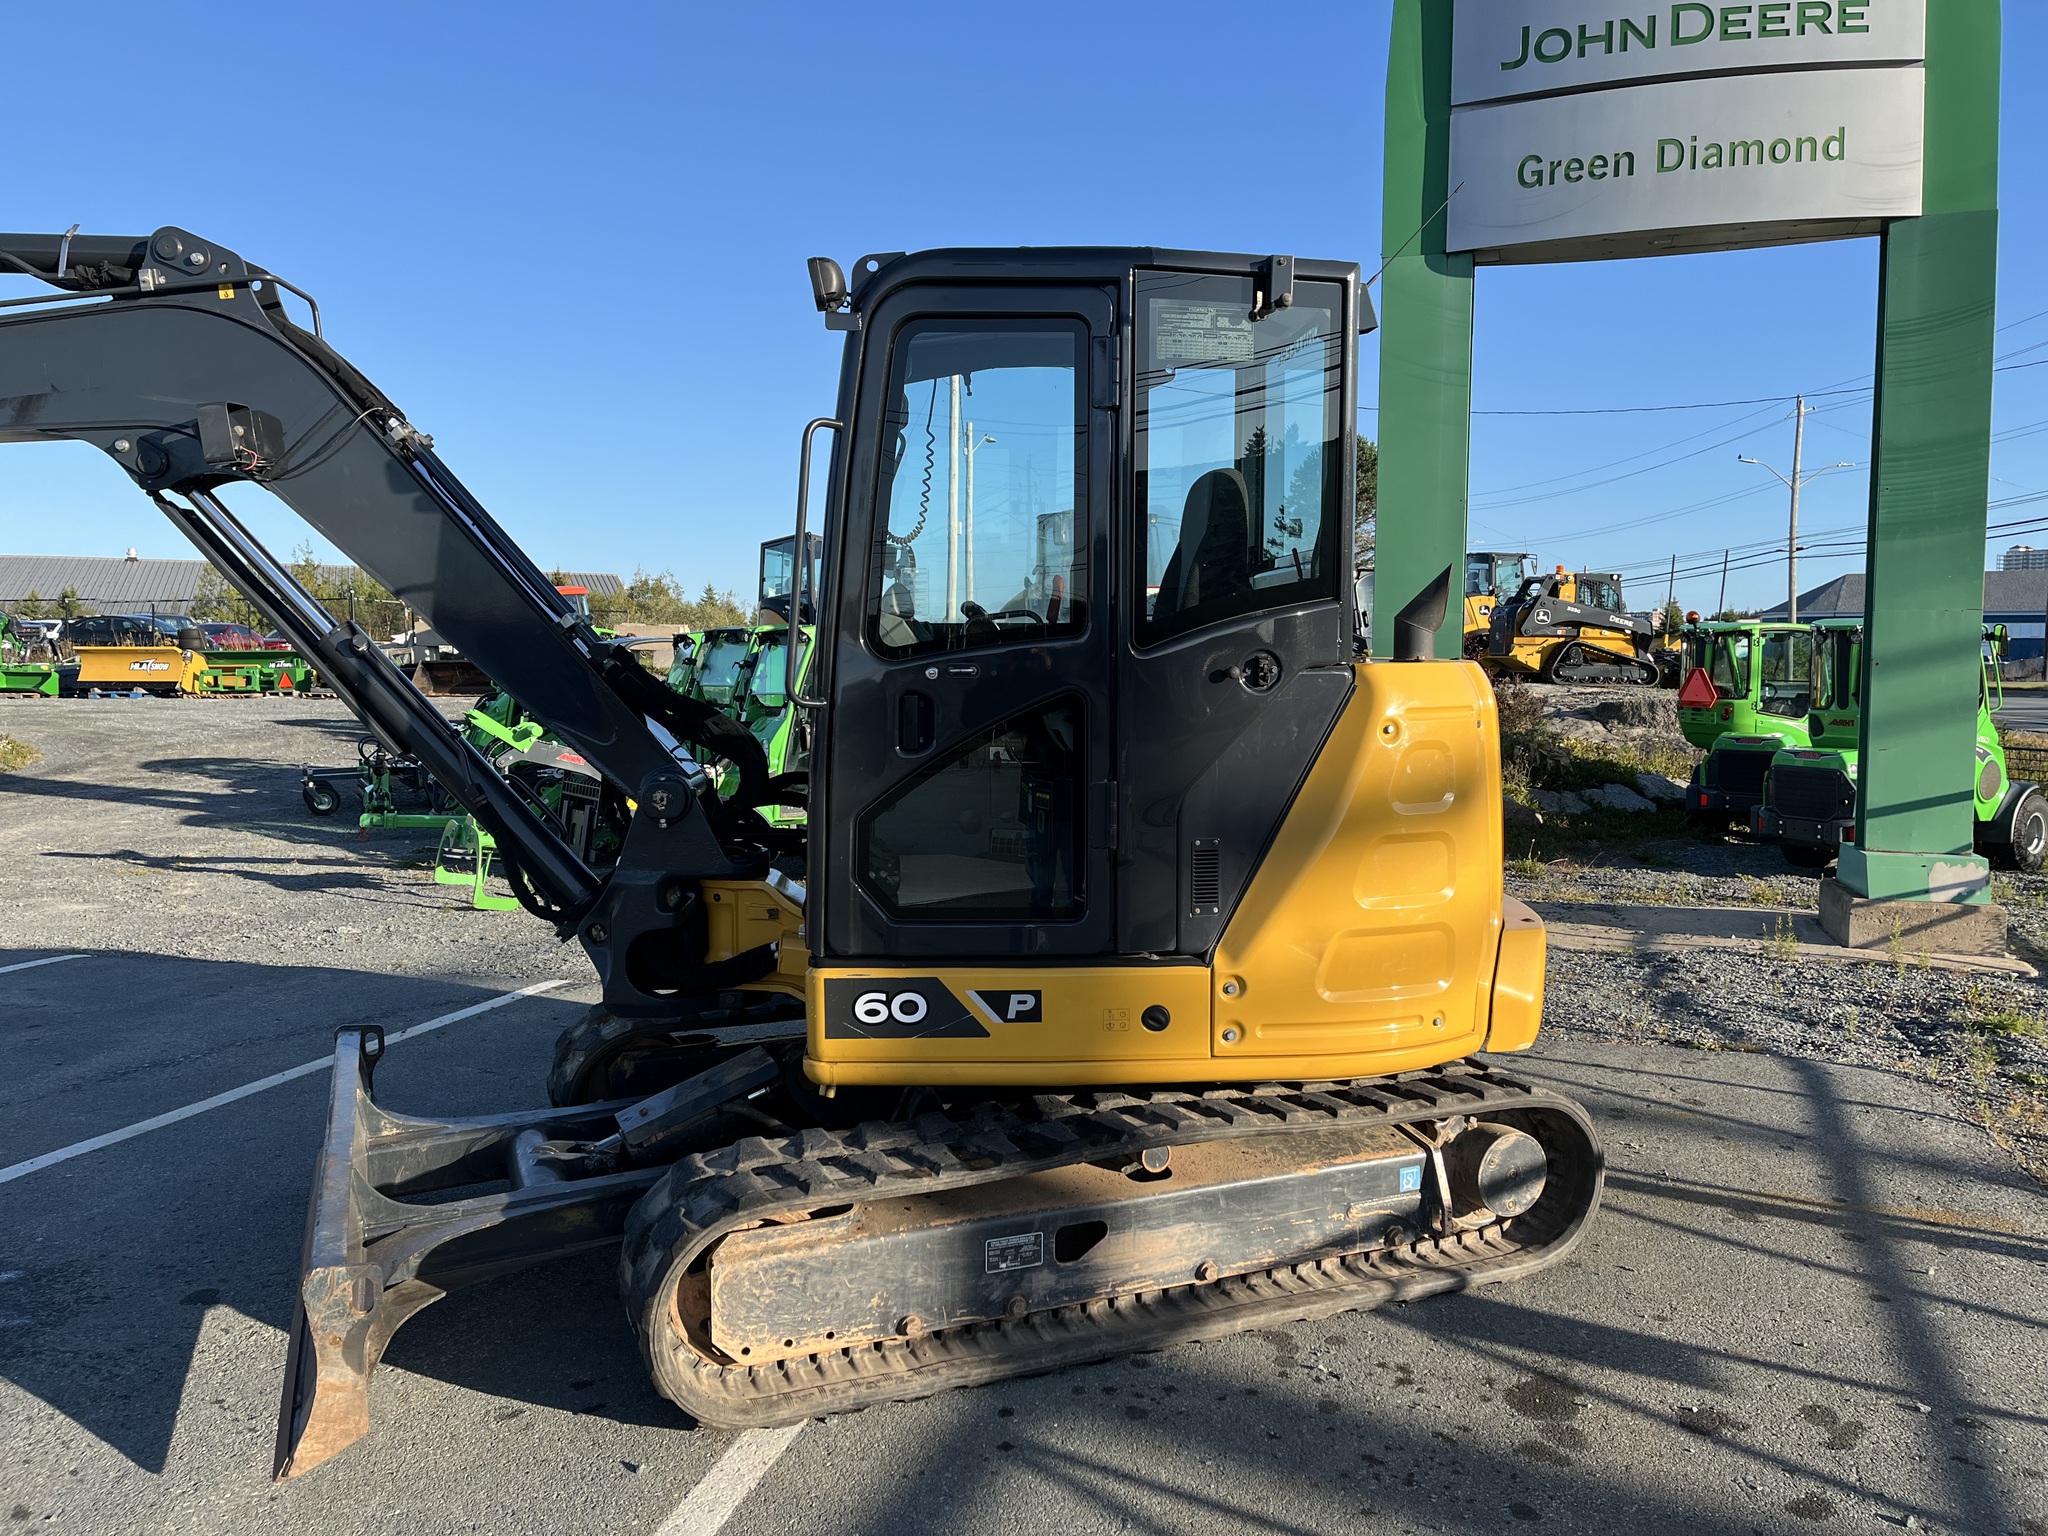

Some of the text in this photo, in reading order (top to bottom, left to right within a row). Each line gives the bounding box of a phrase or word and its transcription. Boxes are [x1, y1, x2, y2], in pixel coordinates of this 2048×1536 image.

[1500, 0, 1871, 71] JOHN DEERE
[1516, 126, 1846, 189] Green Diamond
[1609, 614, 1635, 628] DEERE
[853, 991, 1036, 1024] 60 P
